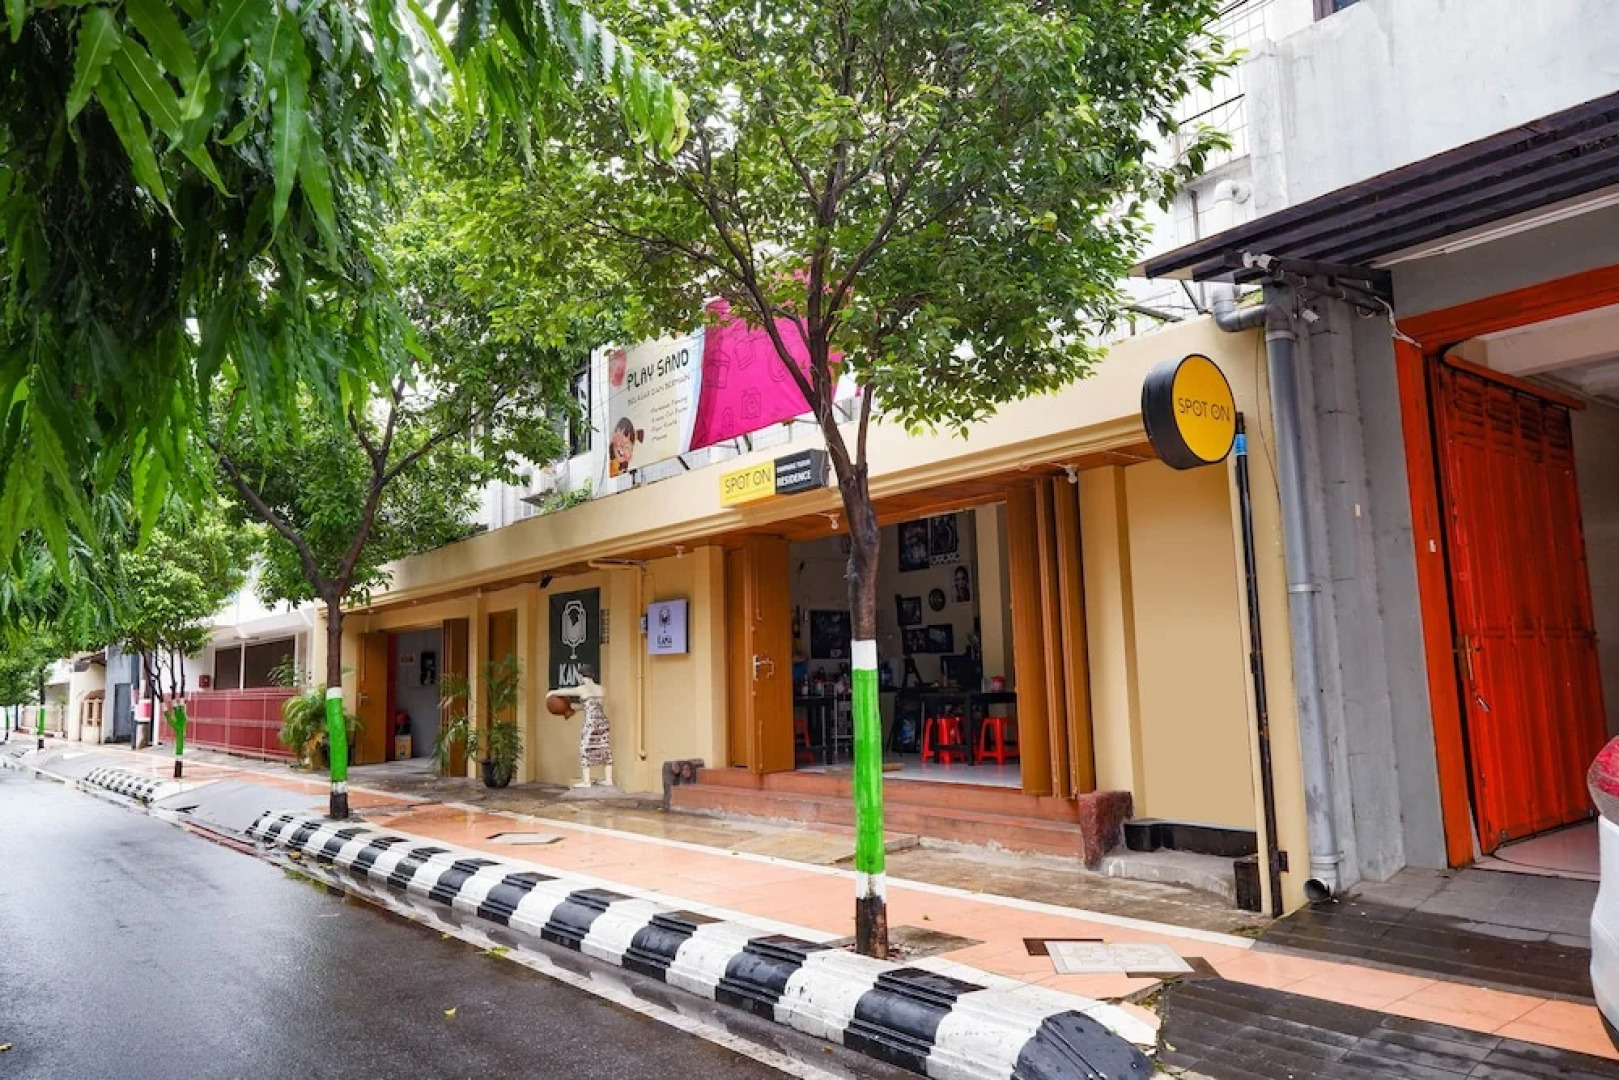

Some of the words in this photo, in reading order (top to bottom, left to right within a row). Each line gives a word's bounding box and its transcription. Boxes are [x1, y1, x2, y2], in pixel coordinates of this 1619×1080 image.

[627, 364, 655, 390] PLAY
[657, 348, 689, 377] SAND
[1178, 397, 1208, 418] SPOT
[1211, 403, 1230, 421] ON
[724, 472, 750, 494] SPOT
[752, 467, 772, 486] ON
[777, 469, 811, 487] RESIDENCE
